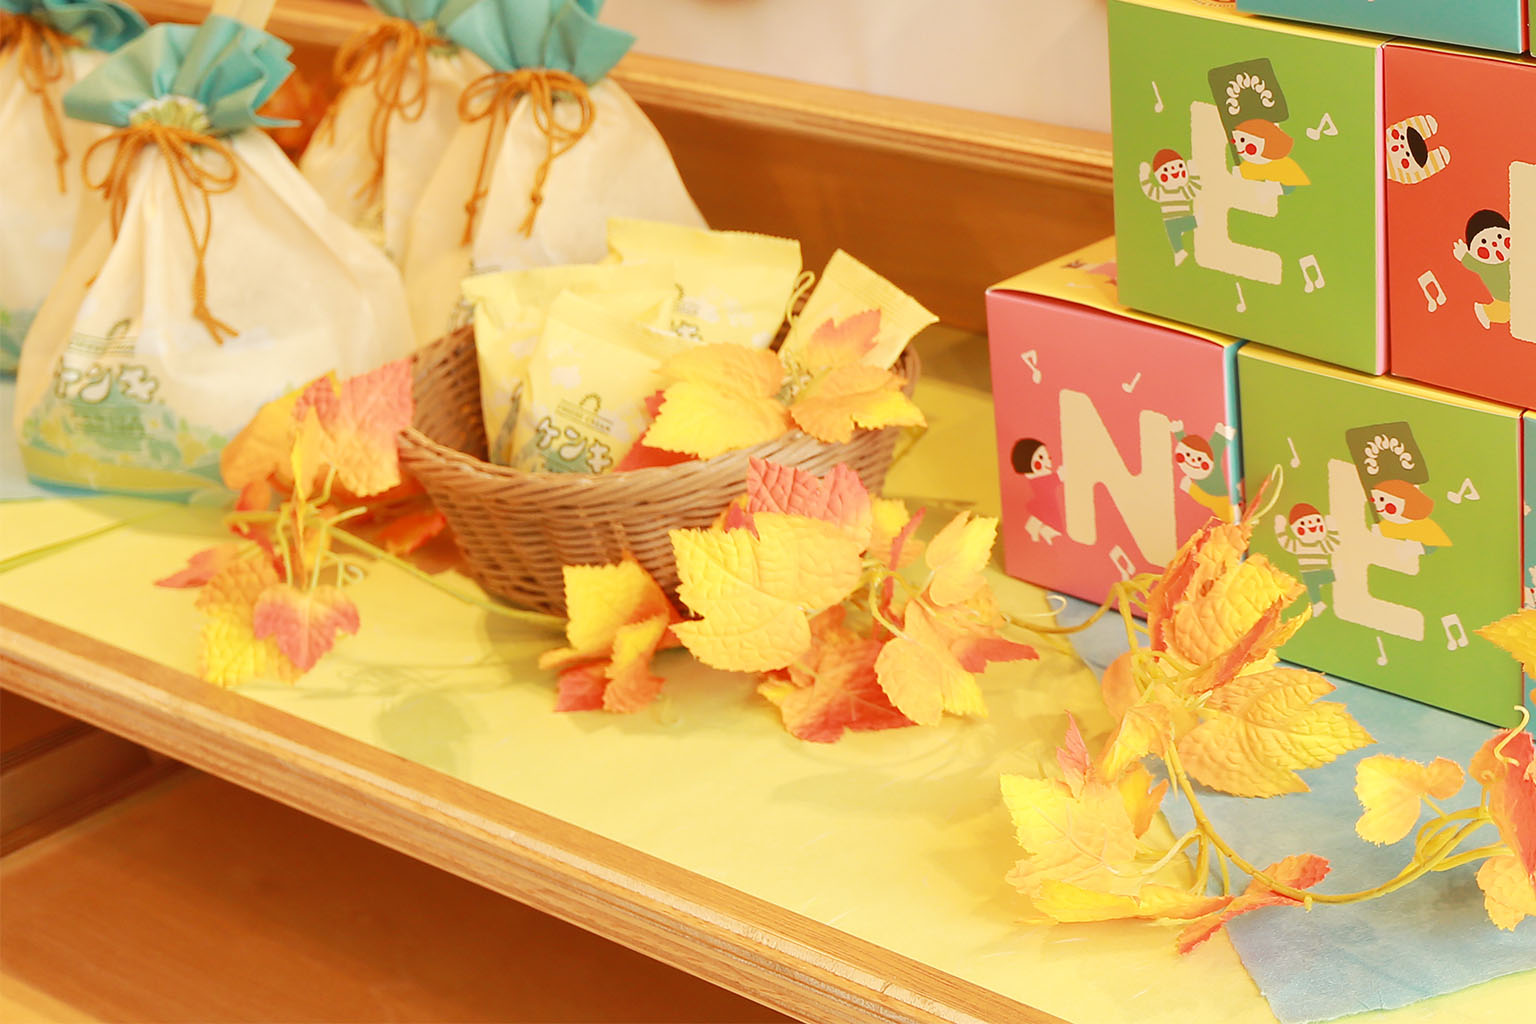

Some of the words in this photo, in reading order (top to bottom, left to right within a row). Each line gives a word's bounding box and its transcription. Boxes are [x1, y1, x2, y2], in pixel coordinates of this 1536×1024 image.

[535, 415, 614, 474] ケンキ
[1058, 388, 1178, 568] N
